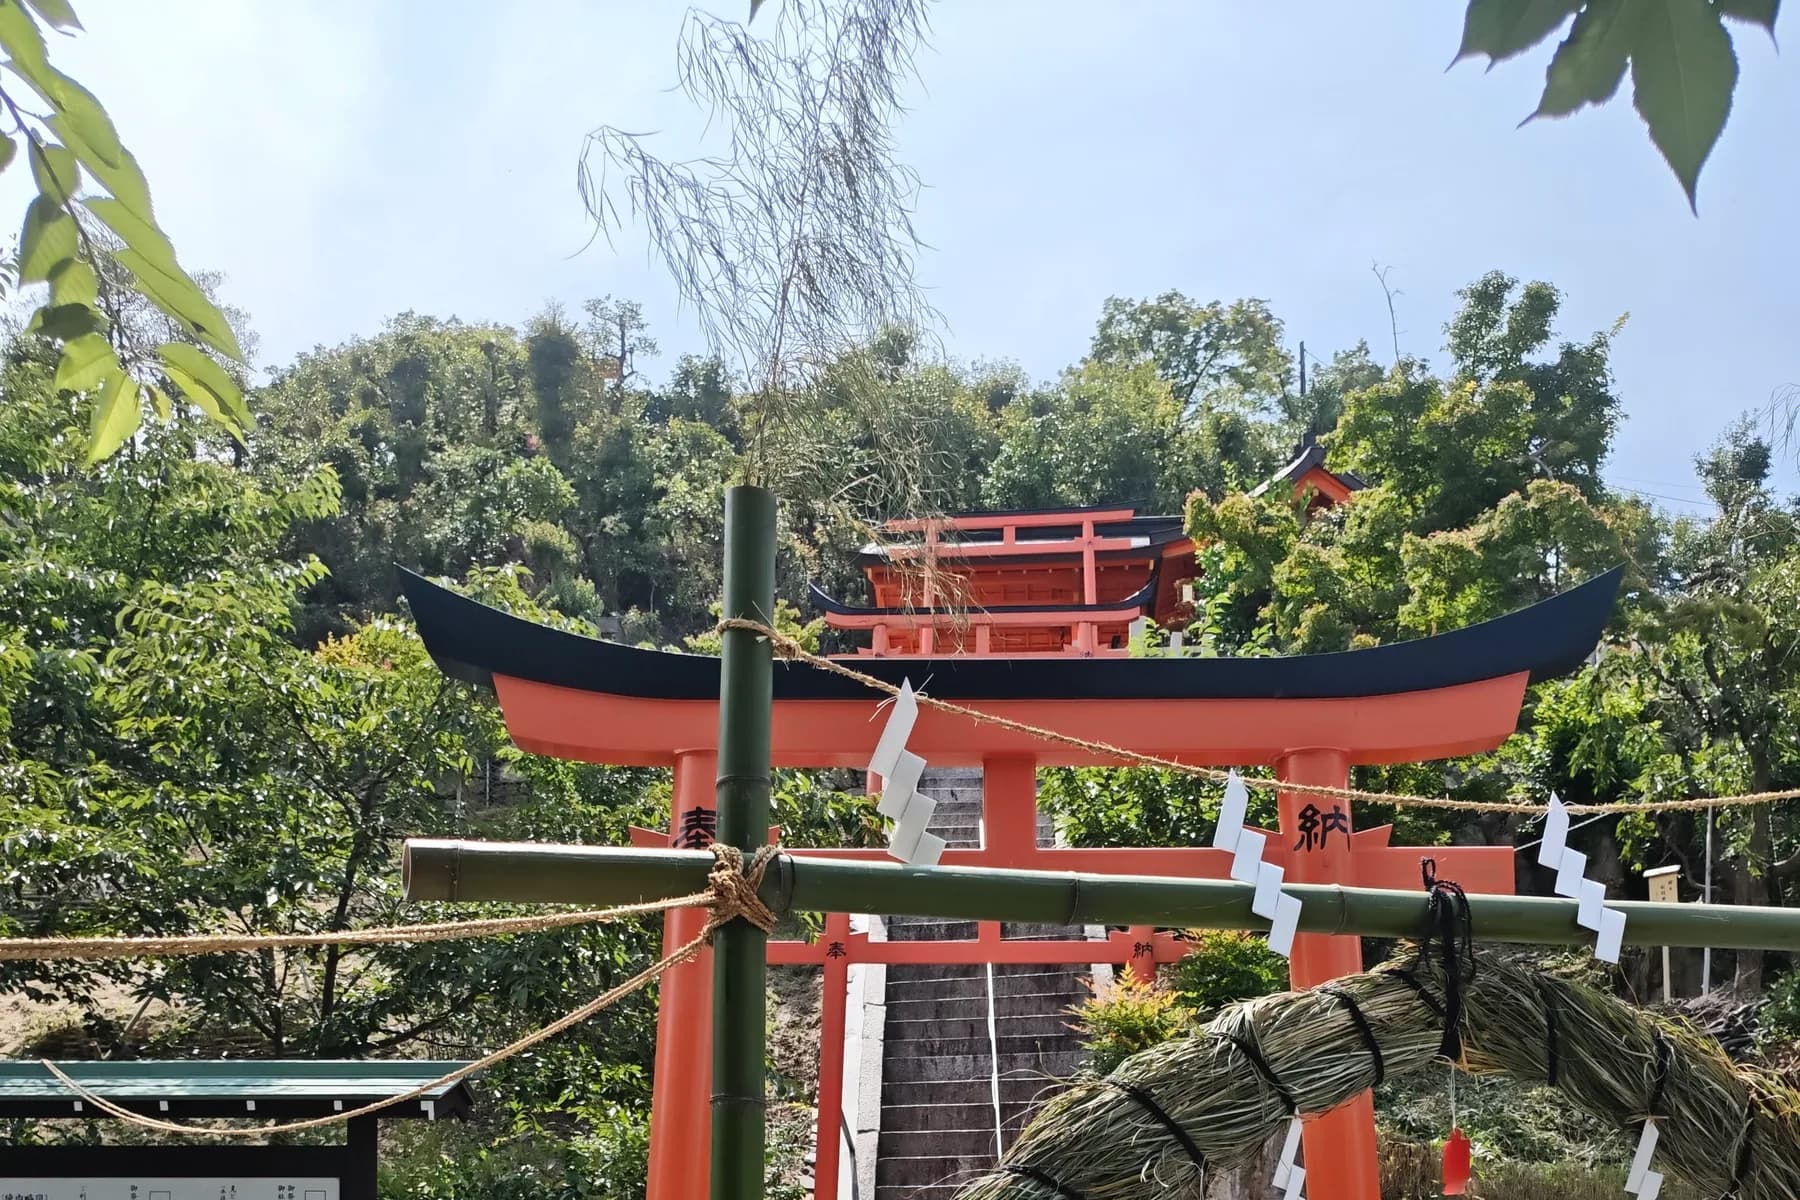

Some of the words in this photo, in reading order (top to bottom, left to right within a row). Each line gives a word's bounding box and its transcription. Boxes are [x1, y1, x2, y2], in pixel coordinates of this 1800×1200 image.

[1293, 803, 1350, 852] 納
[826, 941, 847, 959] 奉
[1132, 942, 1153, 959] 納
